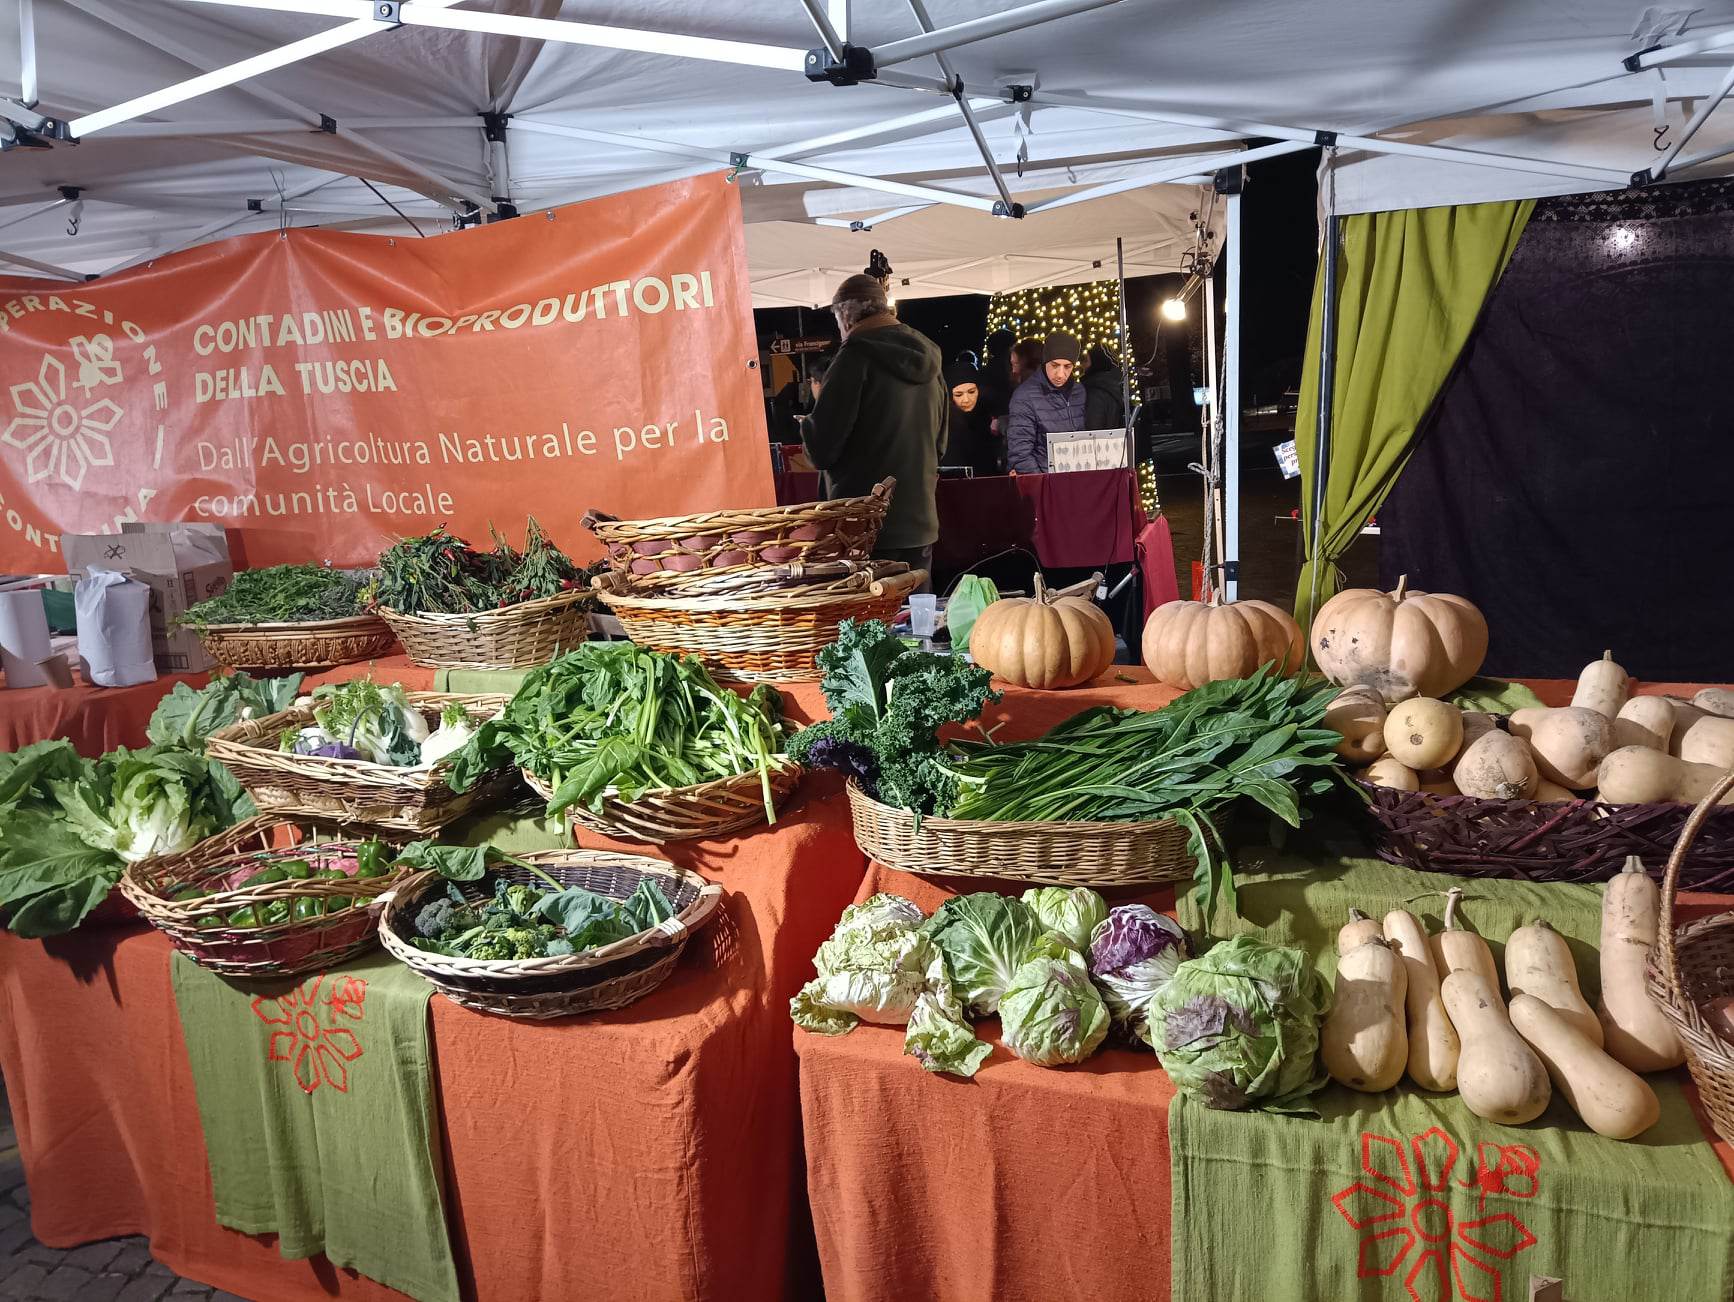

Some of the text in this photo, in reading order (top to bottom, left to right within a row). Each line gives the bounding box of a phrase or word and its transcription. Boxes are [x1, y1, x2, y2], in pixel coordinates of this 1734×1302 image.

[193, 271, 716, 357] CONTADINI E BIOPRODUTTORI
[194, 358, 398, 404] DELLA TUSCIA
[197, 409, 730, 473] Dall'Agricoltura Naturale per la
[194, 483, 455, 517] comunità Locale
